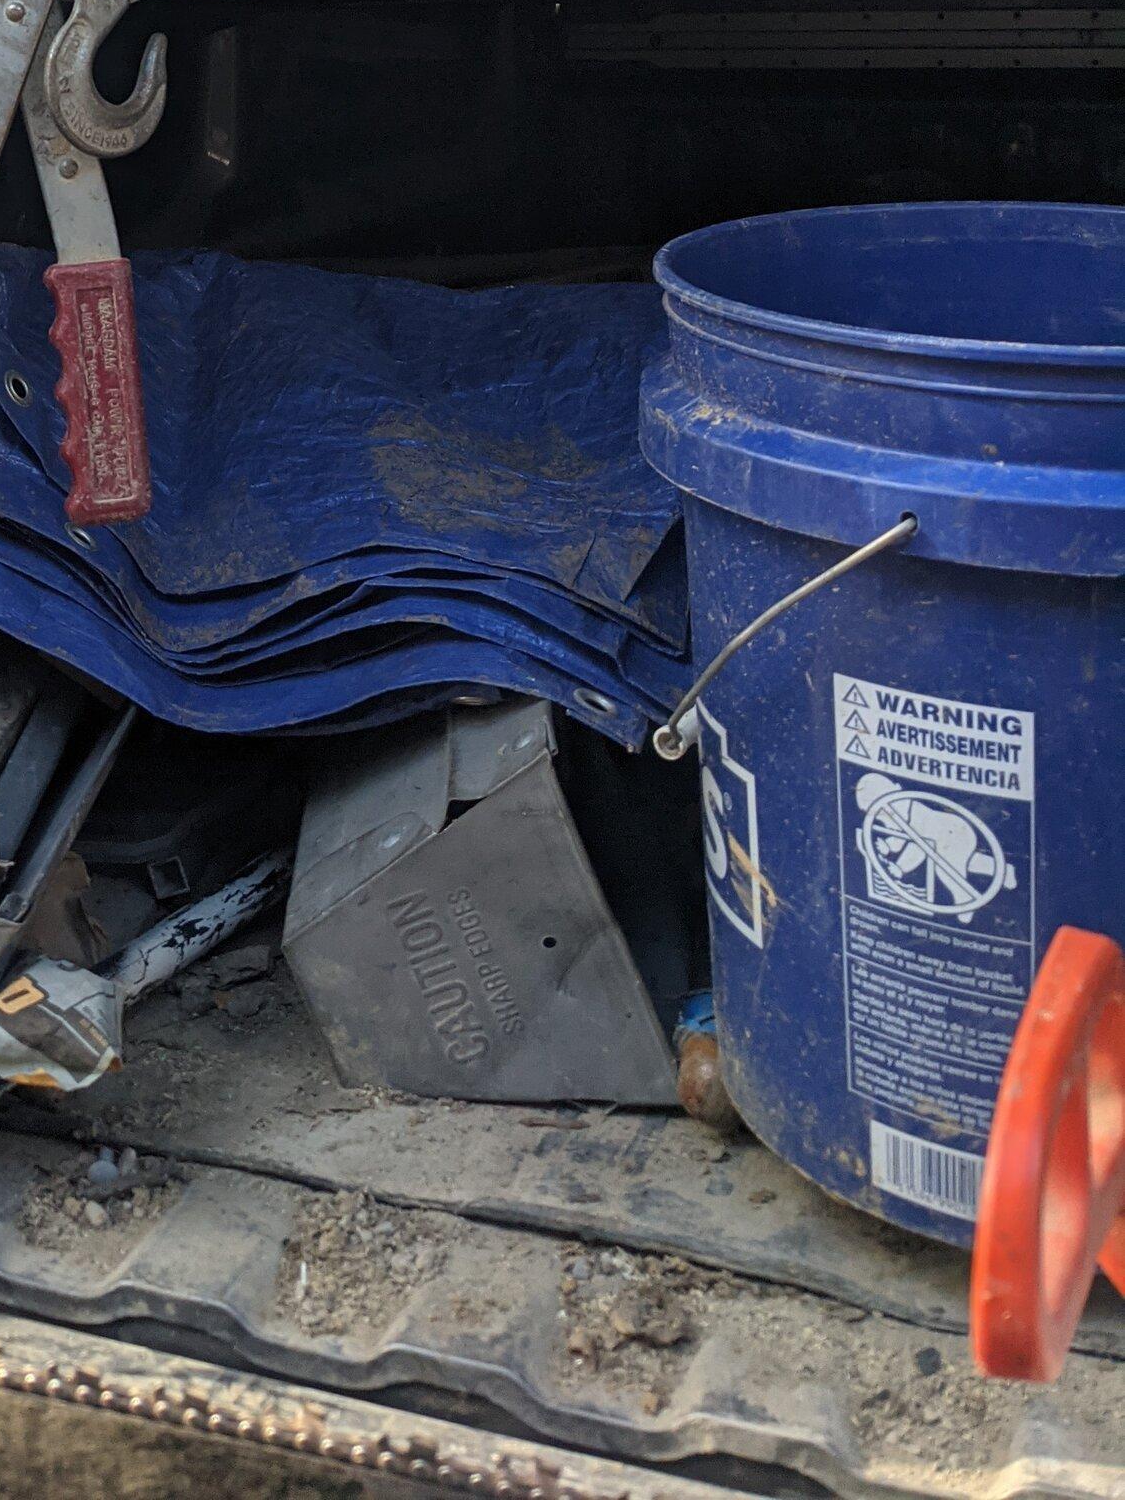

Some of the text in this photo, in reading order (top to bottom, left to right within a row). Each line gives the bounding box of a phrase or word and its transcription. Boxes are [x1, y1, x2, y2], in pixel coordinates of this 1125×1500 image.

[876, 690, 1023, 736] WARNING
[877, 718, 1022, 763] AVERTISSEMENT
[877, 746, 1021, 791] ADVERTENCIA
[849, 904, 888, 926] Children
[891, 920, 908, 932] can
[953, 937, 990, 953] bucket
[387, 889, 490, 1064] CAUTION
[448, 887, 525, 1036] SHARP EDGES
[876, 940, 915, 960] children
[947, 961, 972, 974] from
[975, 967, 1012, 982] bucket
